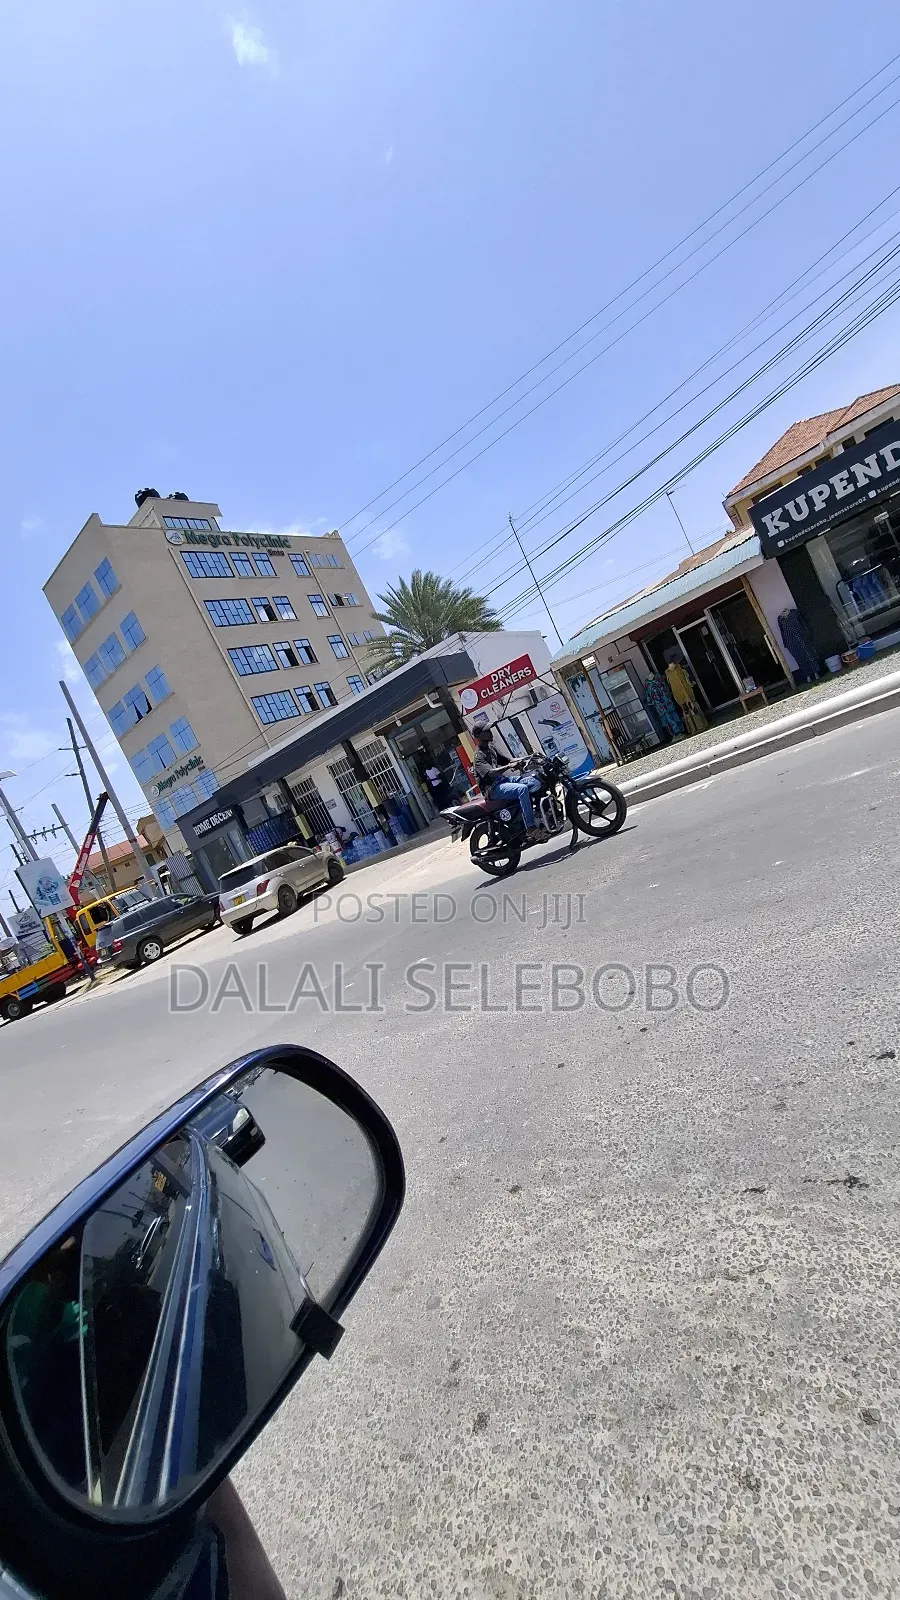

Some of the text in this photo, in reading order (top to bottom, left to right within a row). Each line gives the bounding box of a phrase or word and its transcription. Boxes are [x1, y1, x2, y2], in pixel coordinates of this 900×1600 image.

[231, 531, 292, 550] Polyclinic
[480, 667, 532, 699] CLEANERS
[490, 665, 512, 683] DRY
[192, 819, 212, 836] HOME
